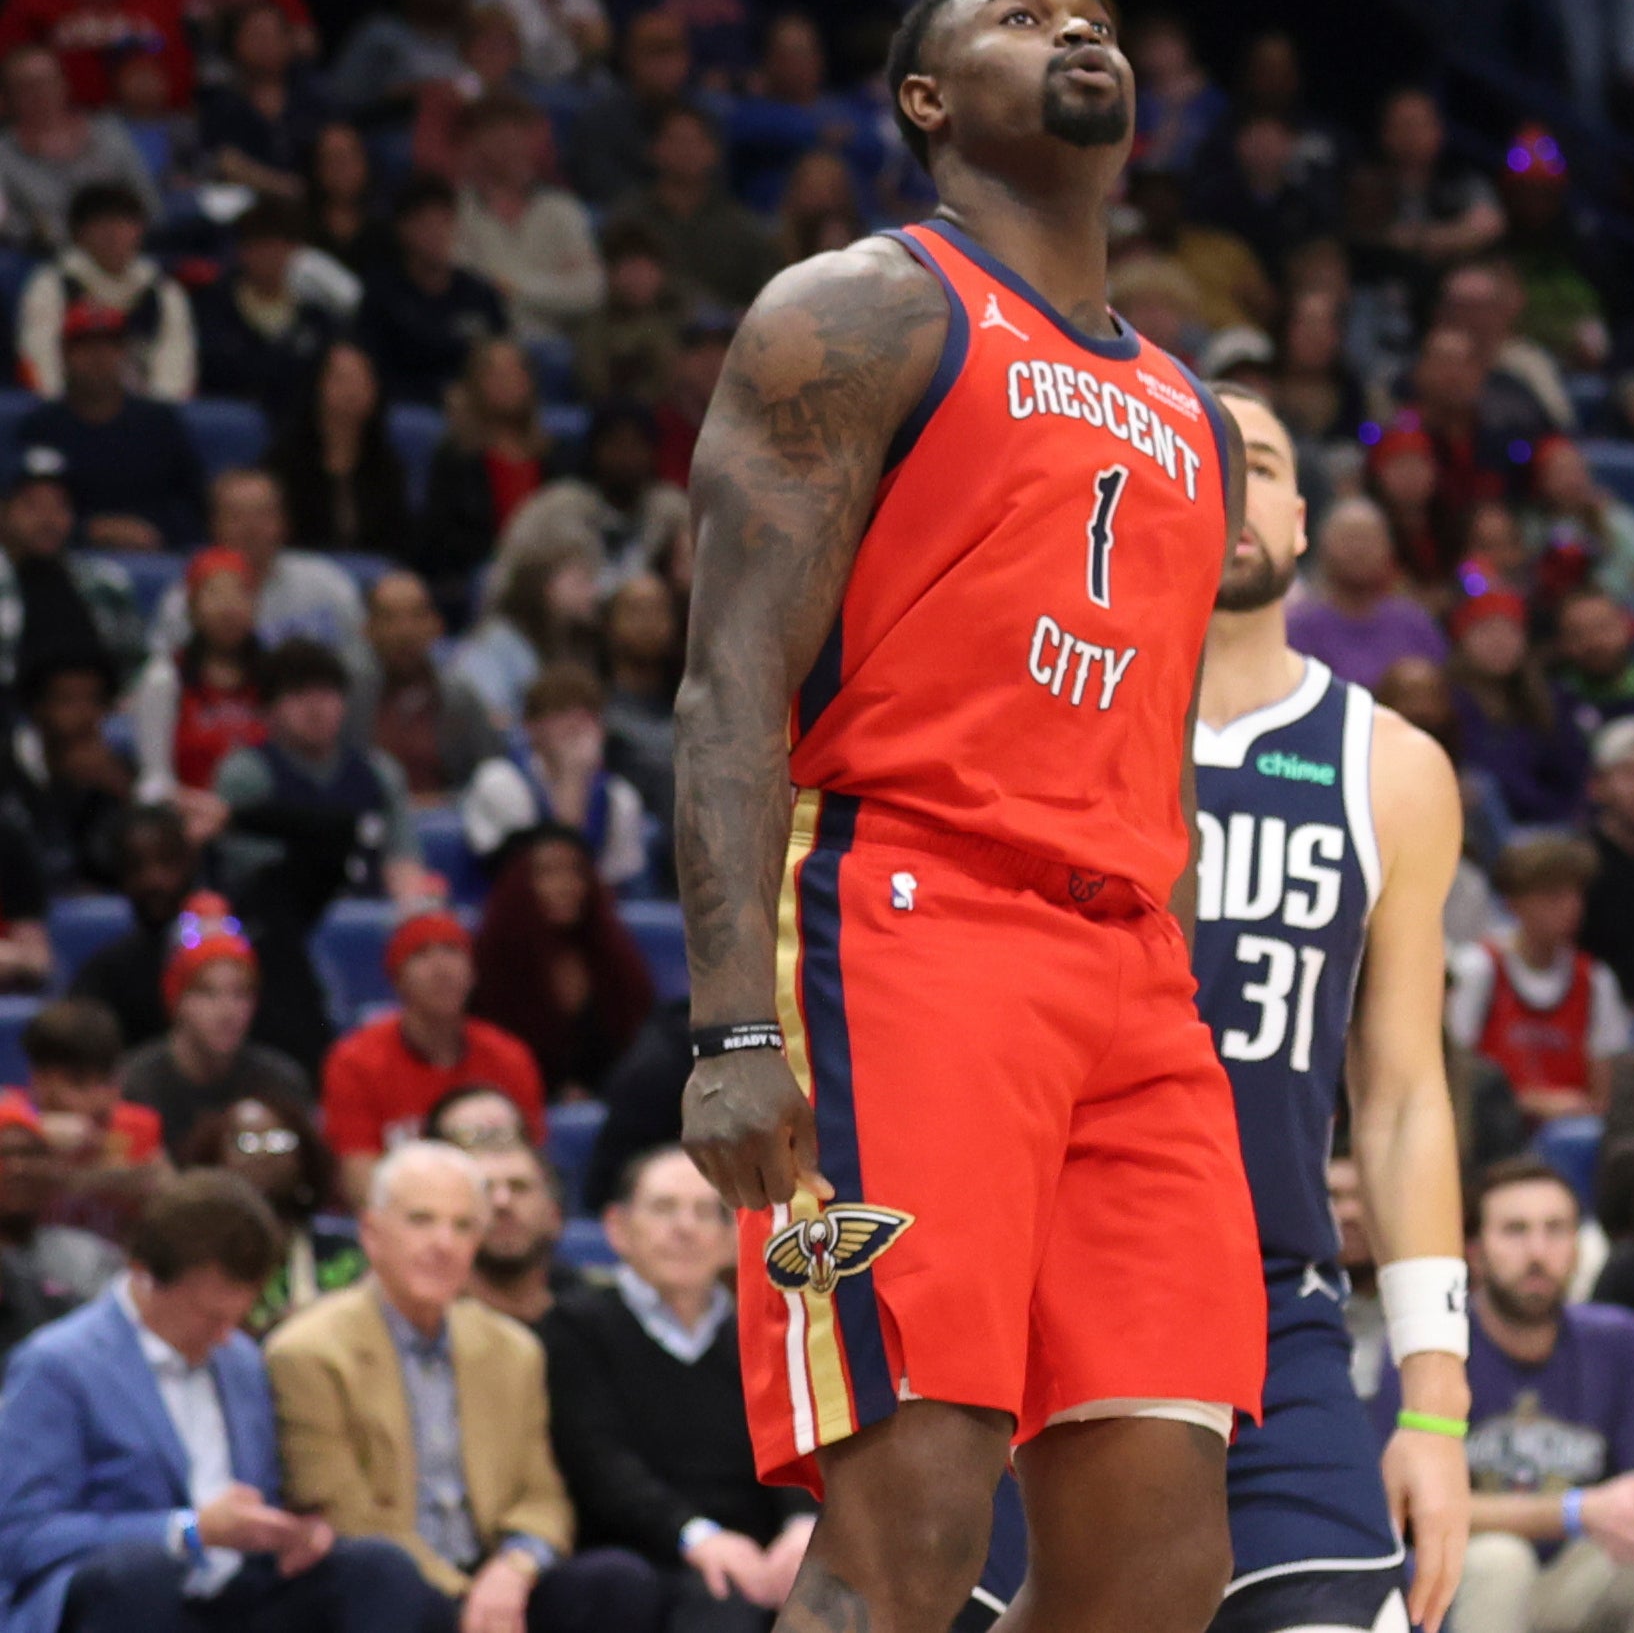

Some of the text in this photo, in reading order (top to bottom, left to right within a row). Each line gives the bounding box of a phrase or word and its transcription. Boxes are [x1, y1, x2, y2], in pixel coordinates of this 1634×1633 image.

[1007, 360, 1201, 502] CRESCENT
[1086, 463, 1129, 609] 1
[1027, 615, 1136, 710] CITY
[1256, 750, 1337, 787] chime
[723, 1033, 768, 1050] READY
[1221, 931, 1326, 1072] 31
